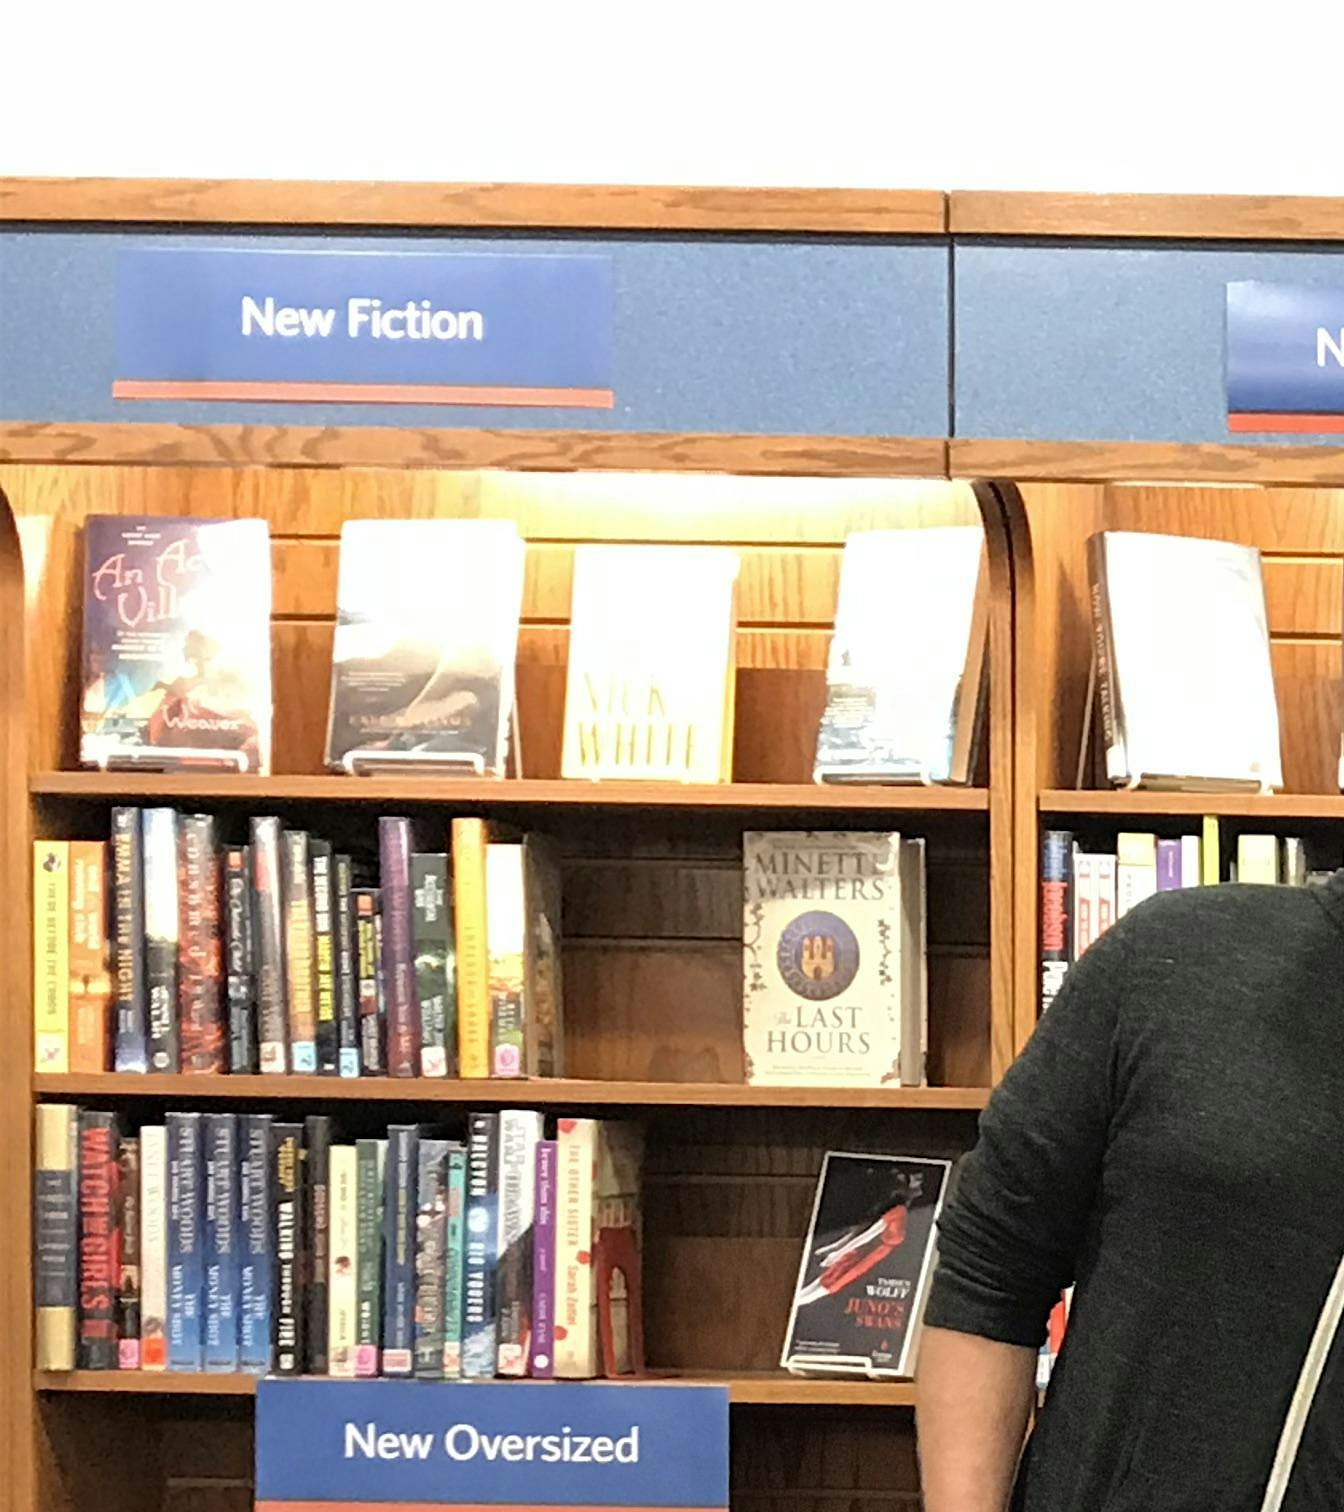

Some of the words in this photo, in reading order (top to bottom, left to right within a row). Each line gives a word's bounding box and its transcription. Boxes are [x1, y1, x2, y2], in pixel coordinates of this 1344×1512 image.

[240, 297, 335, 340] New
[347, 297, 485, 343] Fiction
[756, 878, 885, 901] WALTERS
[116, 948, 134, 1002] NIGHT
[796, 1006, 862, 1029] LAST
[767, 1031, 871, 1054] HOURS
[83, 1128, 112, 1213] WATCH
[470, 1135, 489, 1197] HALCYON
[568, 1145, 580, 1164] THE
[568, 1169, 580, 1204] OTHER
[180, 1192, 195, 1254] WOODS
[215, 1192, 231, 1254] WOODS
[249, 1192, 265, 1254] WOODS
[278, 1200, 295, 1260] WALKING
[568, 1209, 580, 1246] SISTER
[82, 1235, 112, 1310] GIRLS
[171, 1266, 183, 1310] MONEY
[208, 1266, 220, 1310] MONEY
[242, 1266, 253, 1310] MONEY
[281, 1264, 292, 1314] THROUGH
[567, 1265, 579, 1293] Sarah
[184, 1294, 195, 1319] THE
[220, 1294, 232, 1319] THE
[255, 1294, 267, 1319] THE
[278, 1317, 295, 1346] FIRE
[344, 1423, 431, 1461] New
[445, 1424, 639, 1464] Oversized
